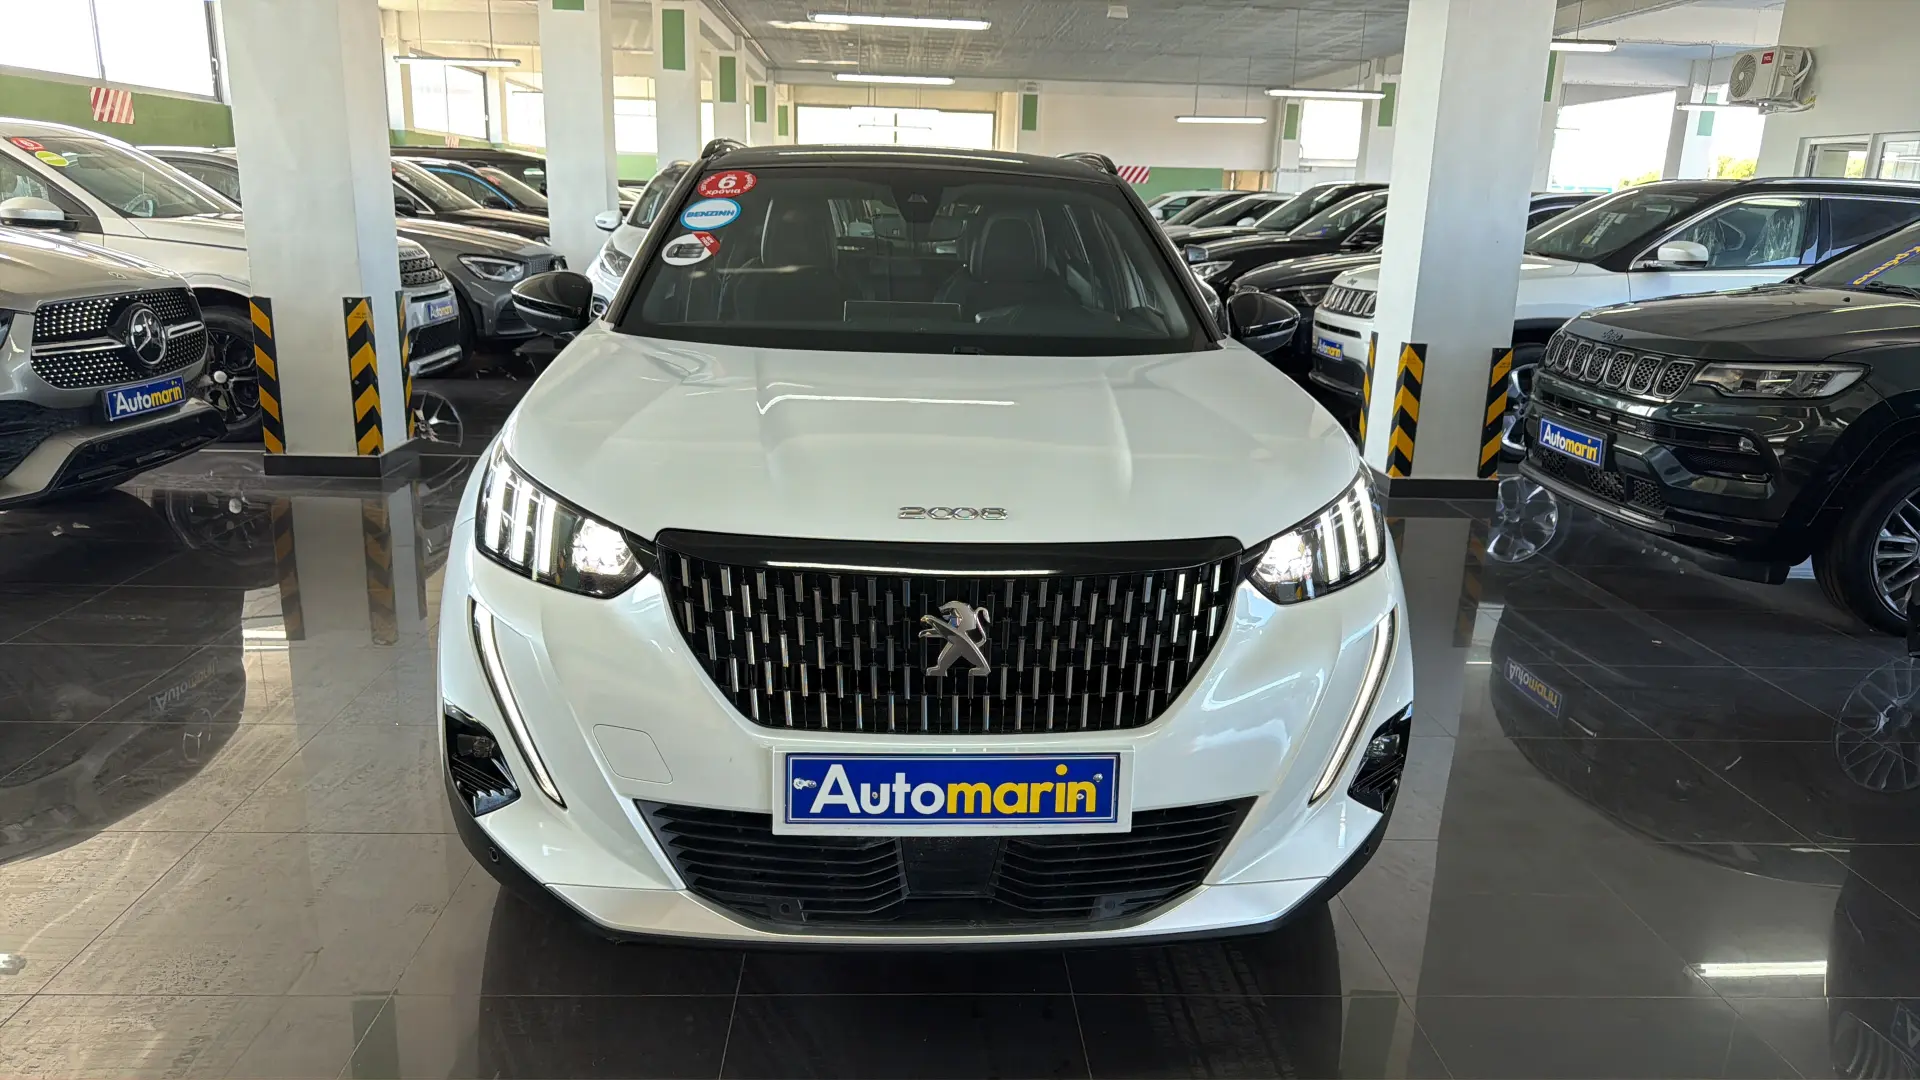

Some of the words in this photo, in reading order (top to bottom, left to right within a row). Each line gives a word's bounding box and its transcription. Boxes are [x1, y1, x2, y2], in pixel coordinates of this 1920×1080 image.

[718, 176, 737, 189] 6
[115, 380, 183, 415] Automarin
[1542, 423, 1598, 462] Automarin
[898, 506, 1008, 521] 2008
[809, 763, 1097, 815] Automarin
